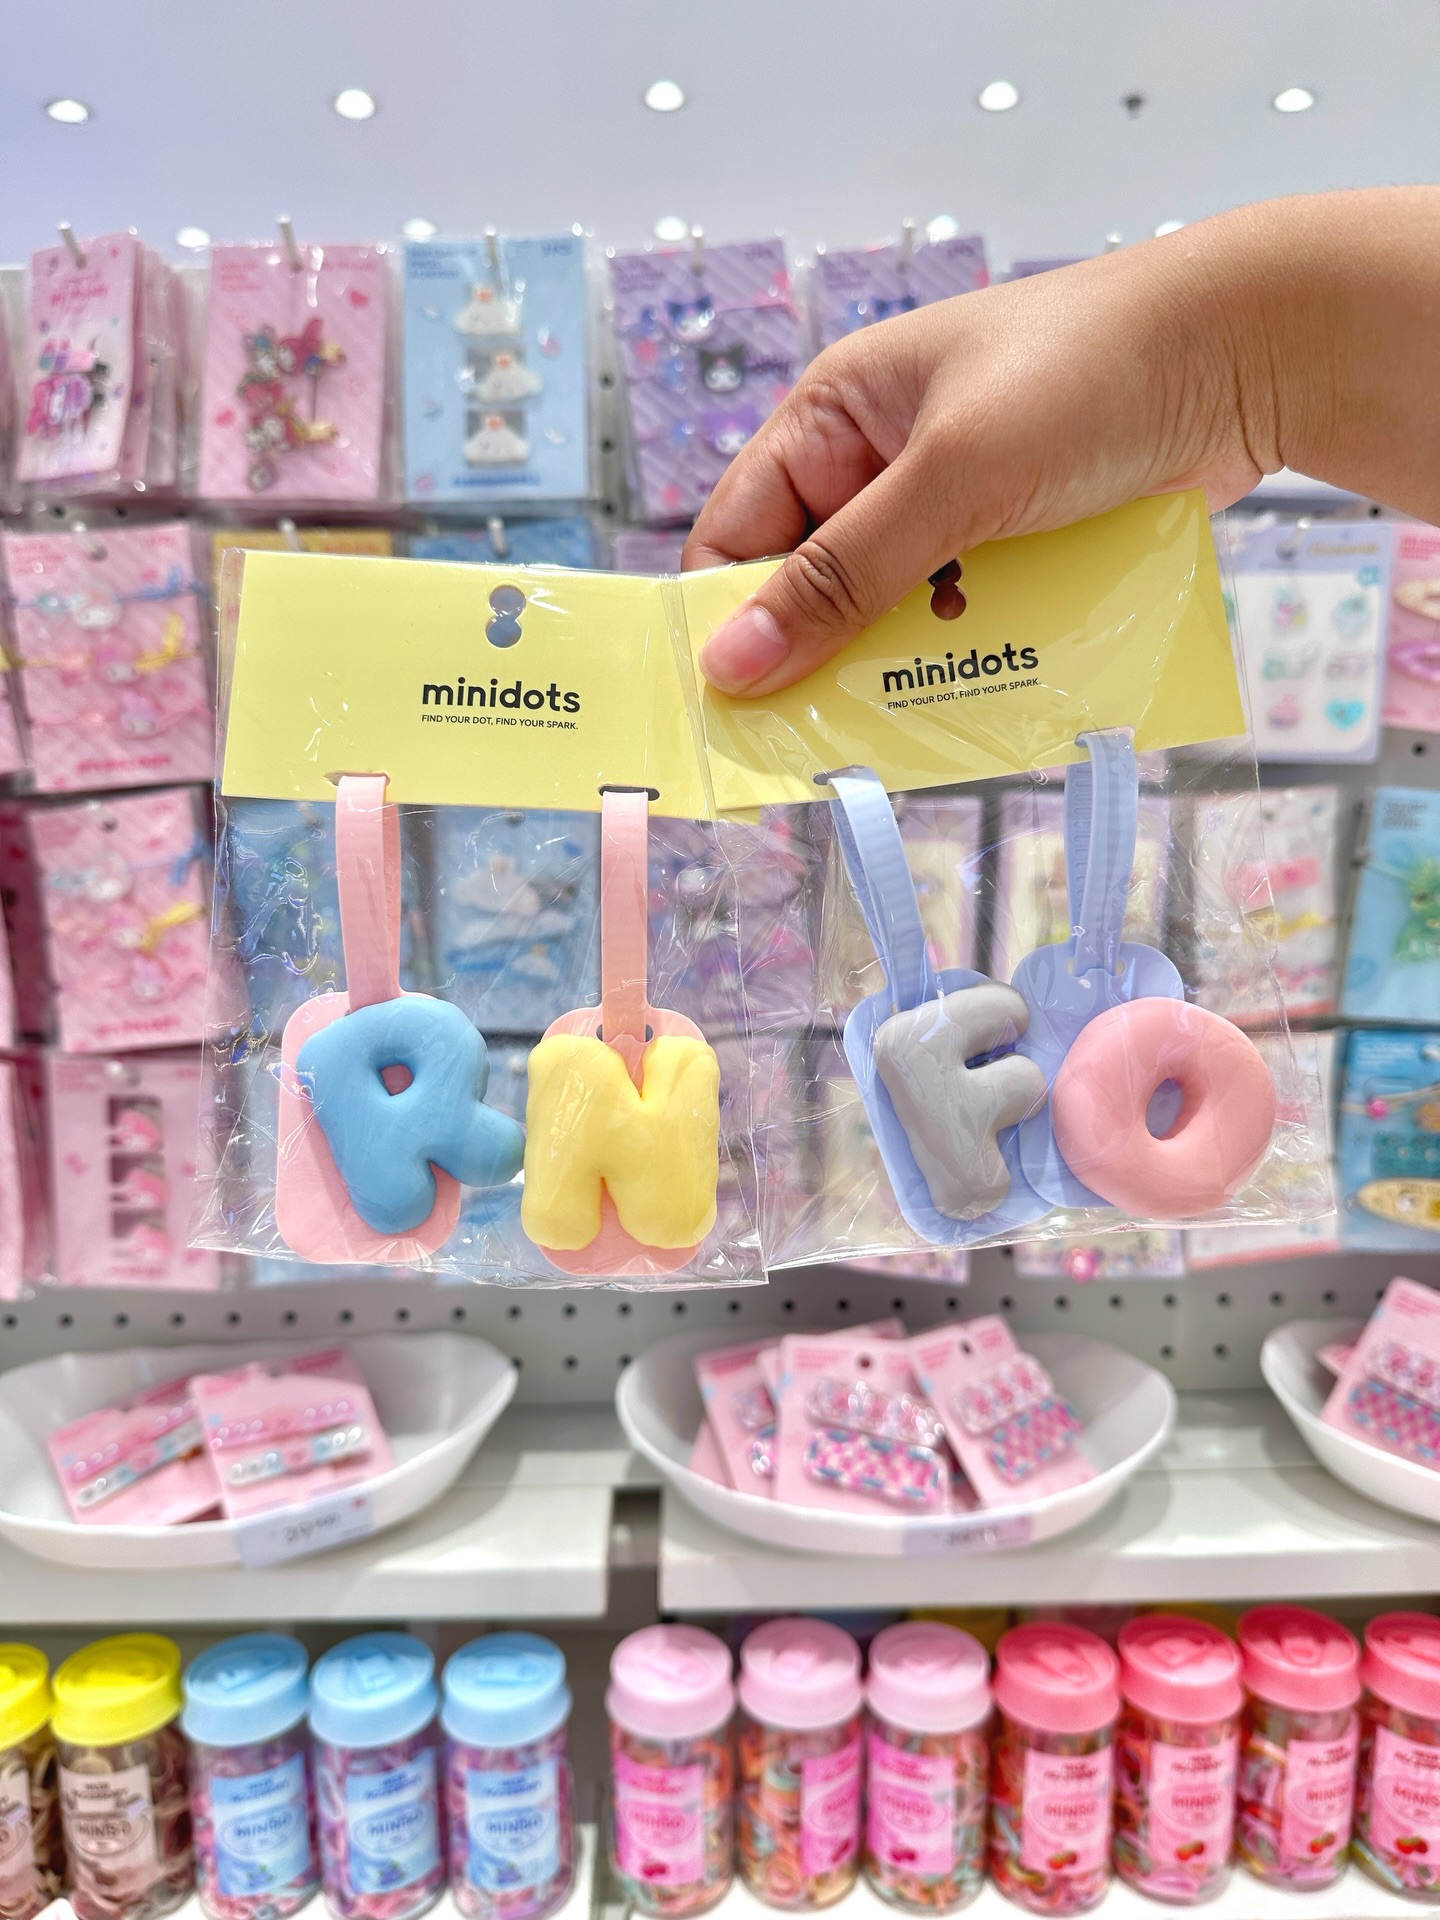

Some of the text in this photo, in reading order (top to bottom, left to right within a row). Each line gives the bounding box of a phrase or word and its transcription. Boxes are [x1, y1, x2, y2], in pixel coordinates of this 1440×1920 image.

[421, 714, 579, 730] FIND YOUR DOT, FIND YOUR SPARK.
[422, 676, 581, 713] minidots
[882, 642, 1039, 693] minidots
[887, 677, 1041, 710] FIND YOUR DOT, FIND YOUR SPARK.
[296, 996, 526, 1235] R
[521, 1033, 719, 1251] N
[873, 982, 1047, 1221] F
[1053, 996, 1278, 1219] O
